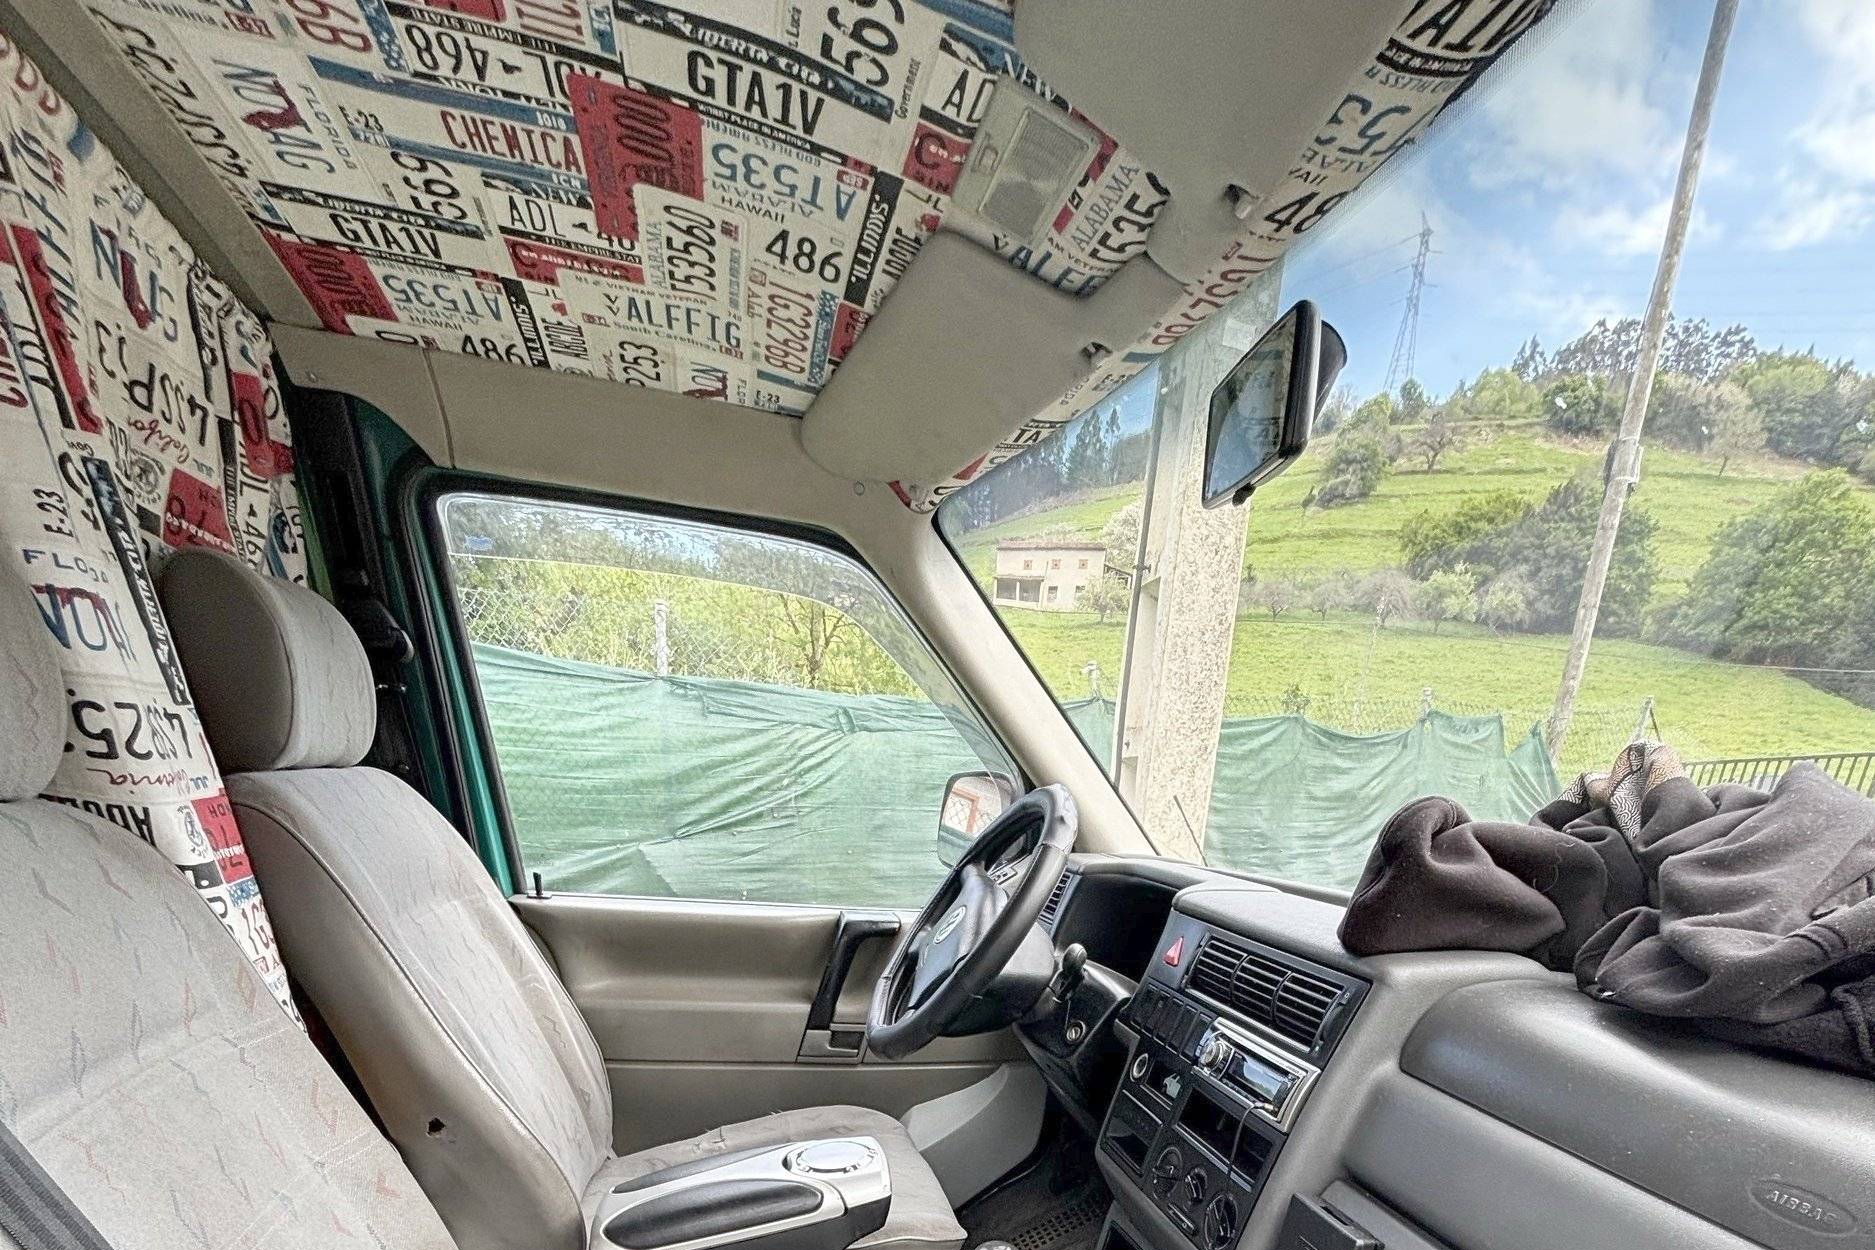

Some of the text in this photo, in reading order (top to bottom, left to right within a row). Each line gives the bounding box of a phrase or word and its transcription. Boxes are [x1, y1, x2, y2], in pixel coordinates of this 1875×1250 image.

[508, 193, 567, 238] ADL
[721, 195, 786, 224] HAWAII
[764, 229, 844, 284] 486
[627, 296, 743, 350] ALFFIG
